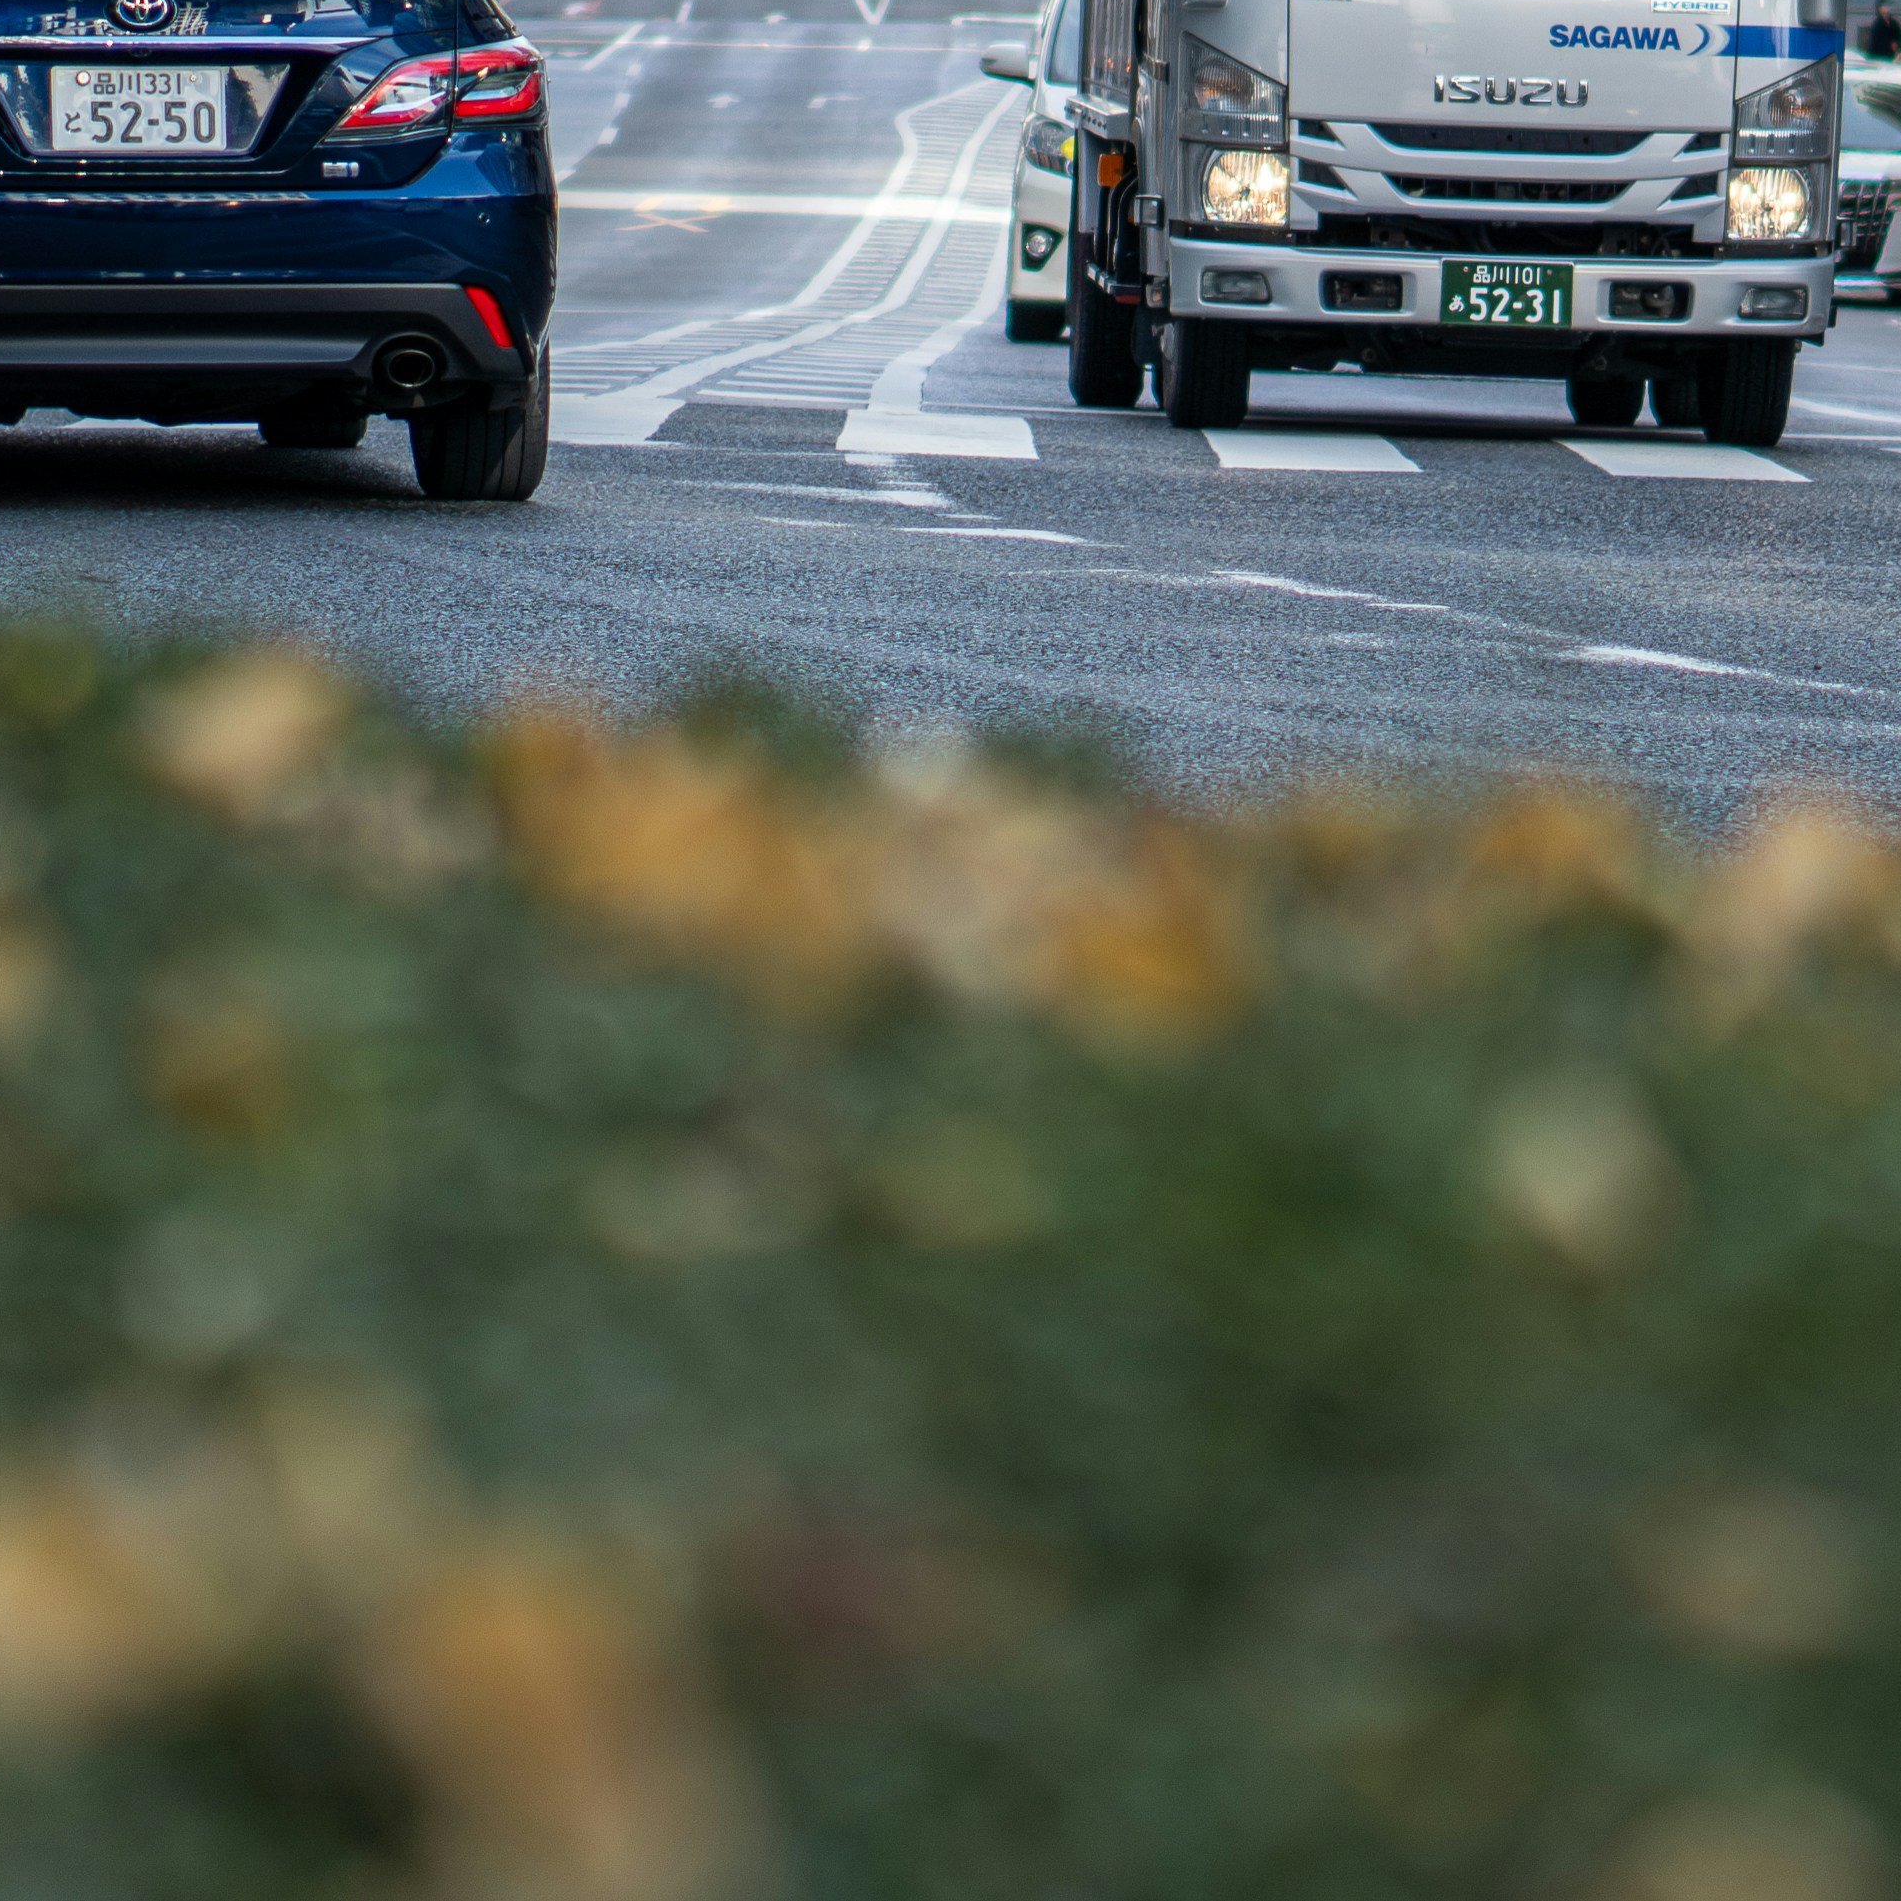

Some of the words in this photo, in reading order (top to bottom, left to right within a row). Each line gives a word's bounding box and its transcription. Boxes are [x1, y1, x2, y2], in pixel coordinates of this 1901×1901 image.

[1652, 0, 1728, 12] HYBRID
[1549, 24, 1681, 51] SAGAWA
[93, 72, 182, 95] 品川331
[1433, 74, 1589, 109] ISUZU
[64, 111, 82, 134] と
[90, 101, 217, 144] 52-50
[1472, 265, 1541, 286] 品川101
[1448, 294, 1465, 313] あ
[1469, 287, 1560, 325] 52-31
